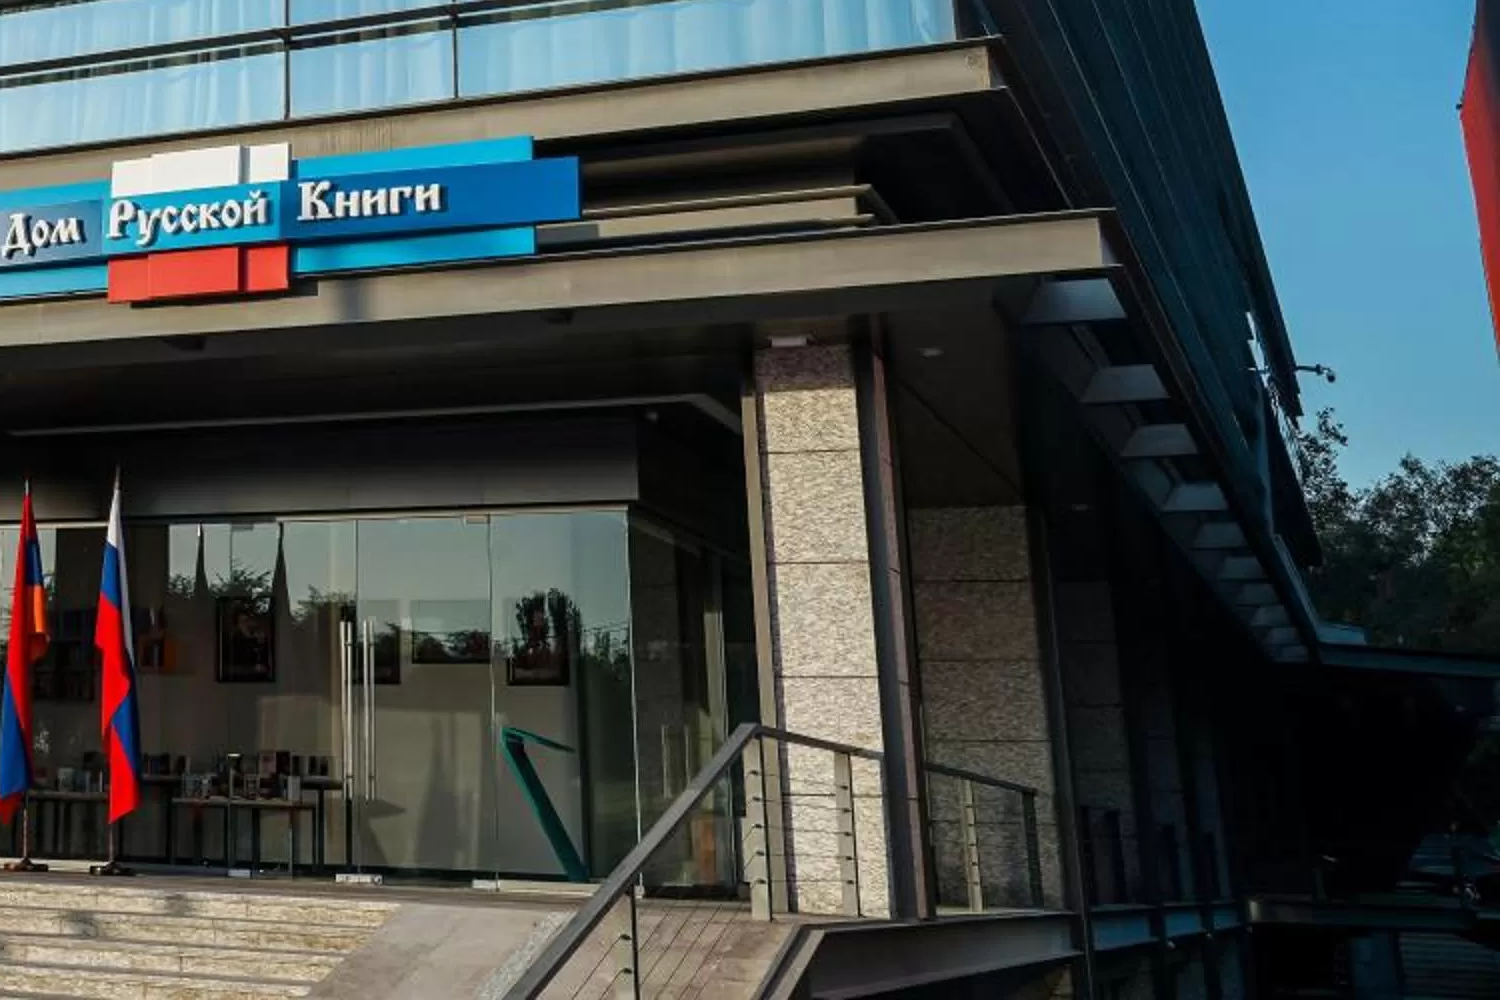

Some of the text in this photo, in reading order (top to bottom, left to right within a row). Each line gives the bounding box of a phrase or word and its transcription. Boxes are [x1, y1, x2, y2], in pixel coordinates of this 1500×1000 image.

[1, 180, 442, 258] Дом Русской Книги
